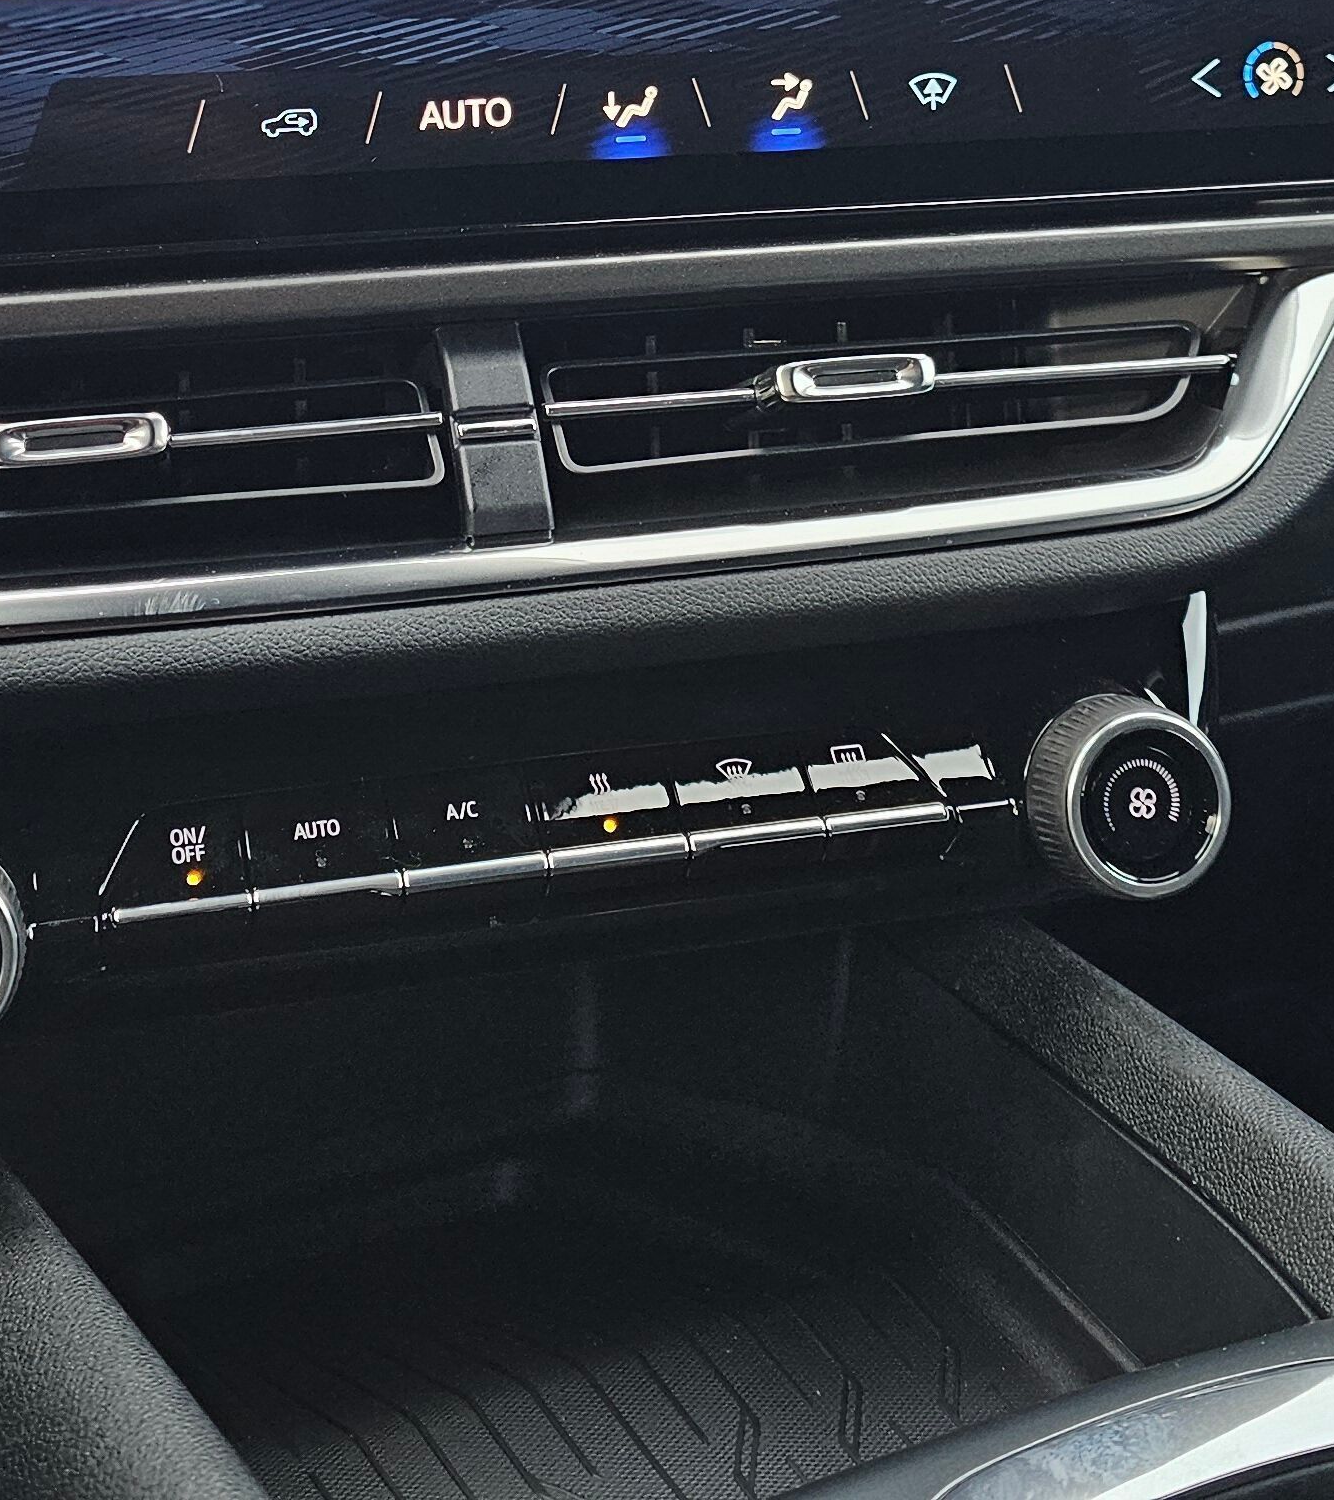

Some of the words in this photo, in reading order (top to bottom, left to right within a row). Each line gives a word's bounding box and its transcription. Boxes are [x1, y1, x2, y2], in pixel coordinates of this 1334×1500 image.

[419, 97, 512, 134] AUTO
[446, 800, 479, 821] A/C
[169, 825, 206, 847] ON/
[293, 818, 341, 841] AUTO
[171, 843, 206, 865] OFF
